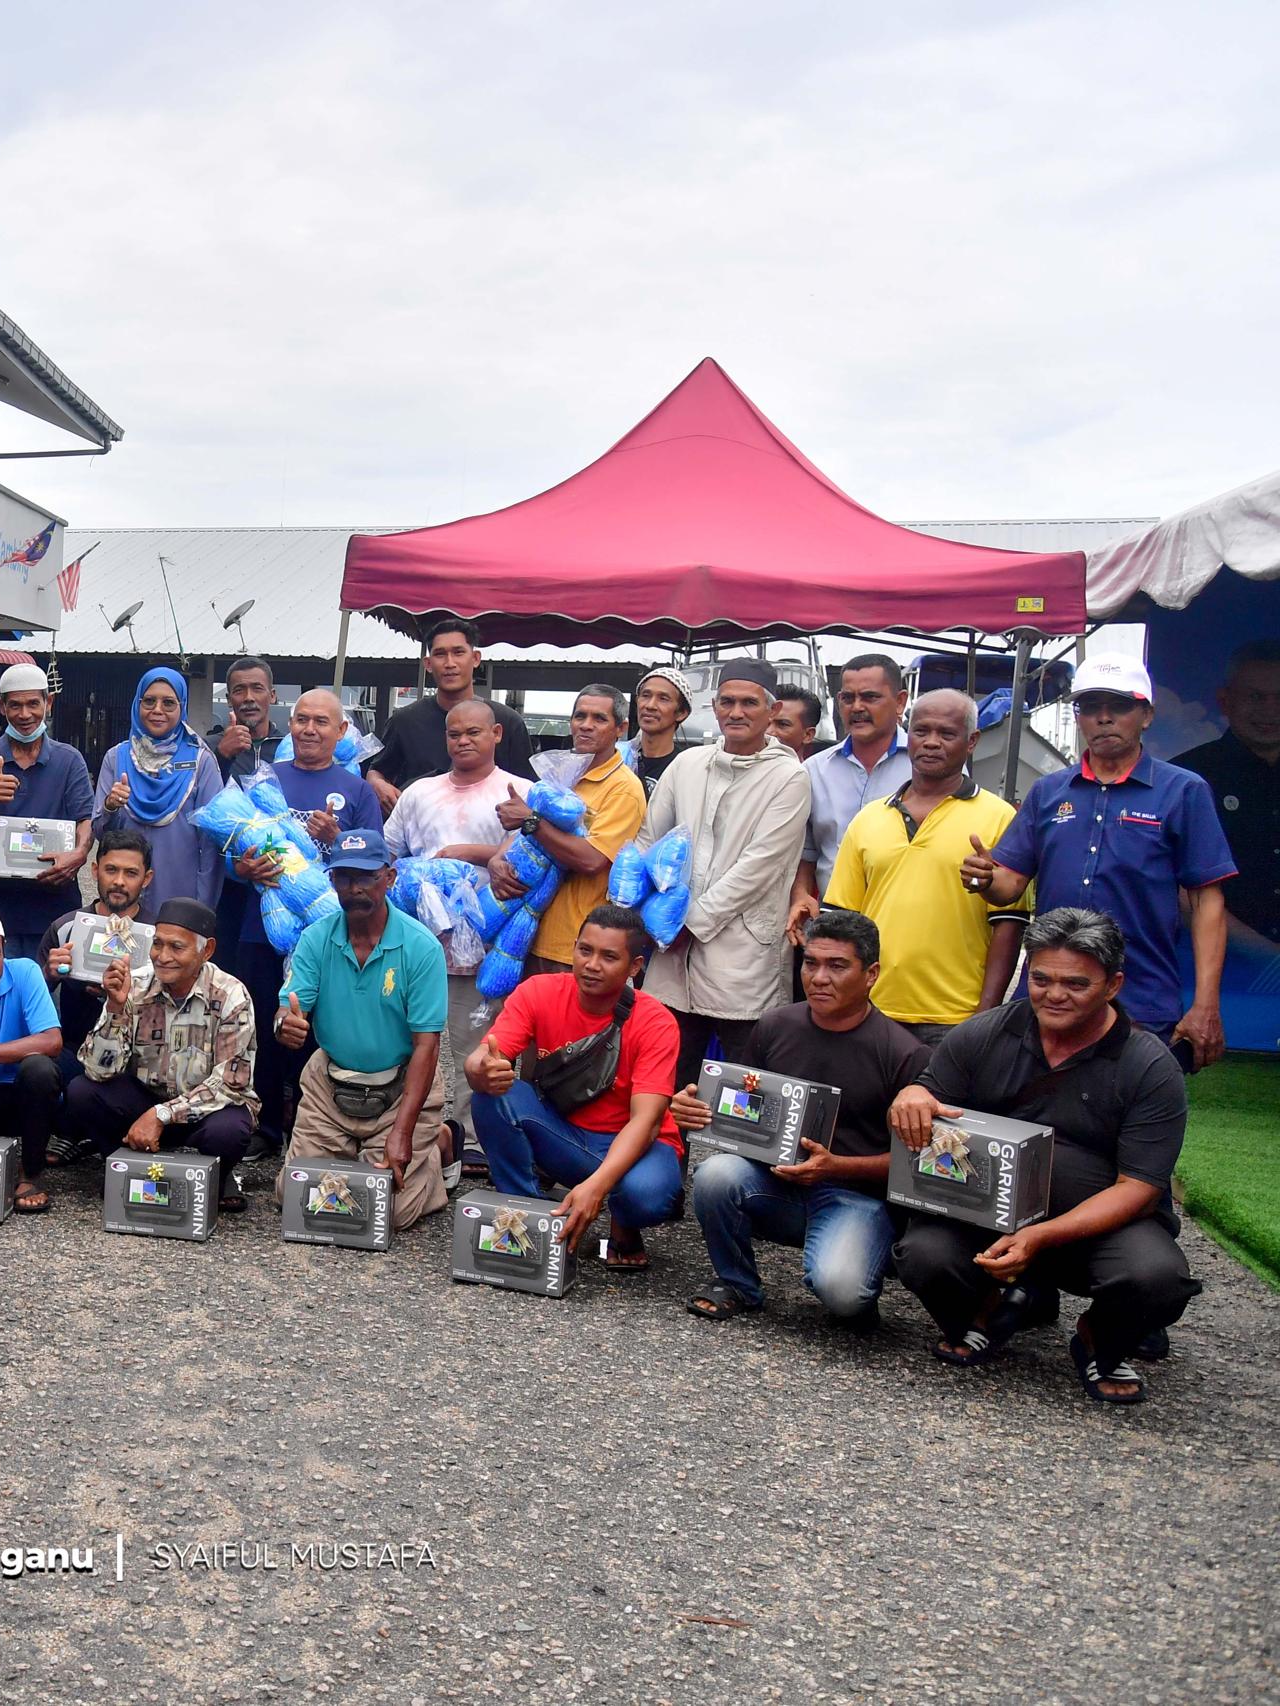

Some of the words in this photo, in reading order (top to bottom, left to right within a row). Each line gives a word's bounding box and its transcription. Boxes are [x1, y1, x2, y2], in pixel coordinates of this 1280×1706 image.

[63, 822, 75, 853] GAR
[780, 1085, 805, 1162] GARMIN
[192, 1168, 206, 1236] GARMIN
[373, 1177, 387, 1244] GARMIN
[995, 1144, 1015, 1226] GARMIN
[546, 1219, 563, 1290] GARMIN
